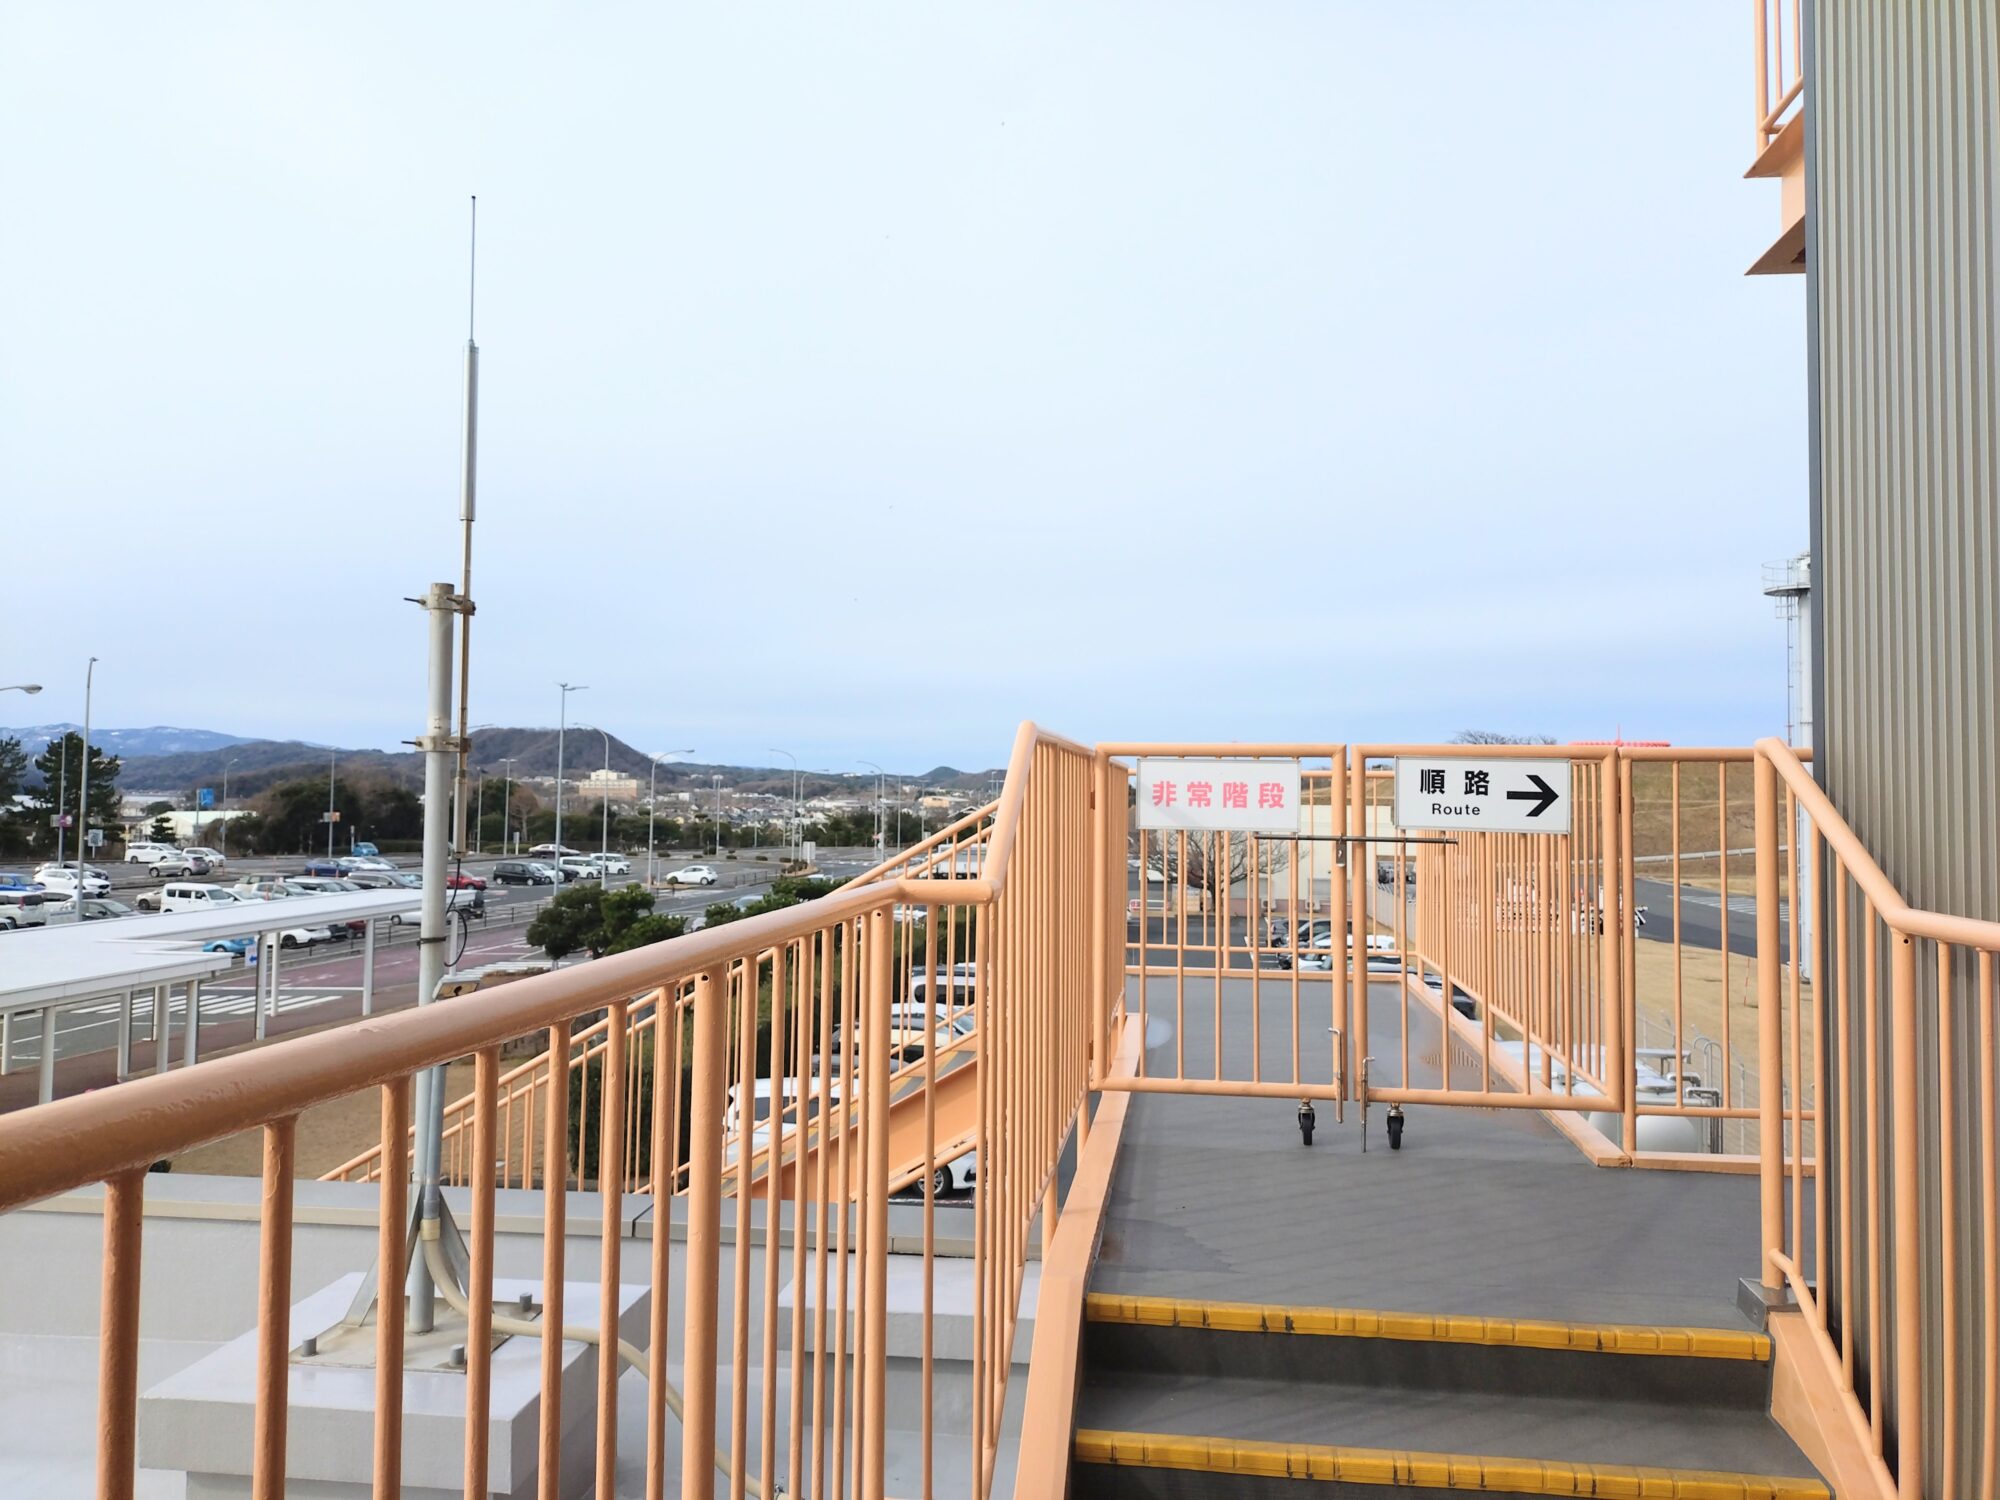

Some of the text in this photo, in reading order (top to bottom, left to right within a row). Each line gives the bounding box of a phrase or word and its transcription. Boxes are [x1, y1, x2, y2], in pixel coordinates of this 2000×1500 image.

[1152, 781, 1285, 809] 非常階段
[1419, 768, 1490, 796] 順路
[1431, 802, 1481, 816] Route
